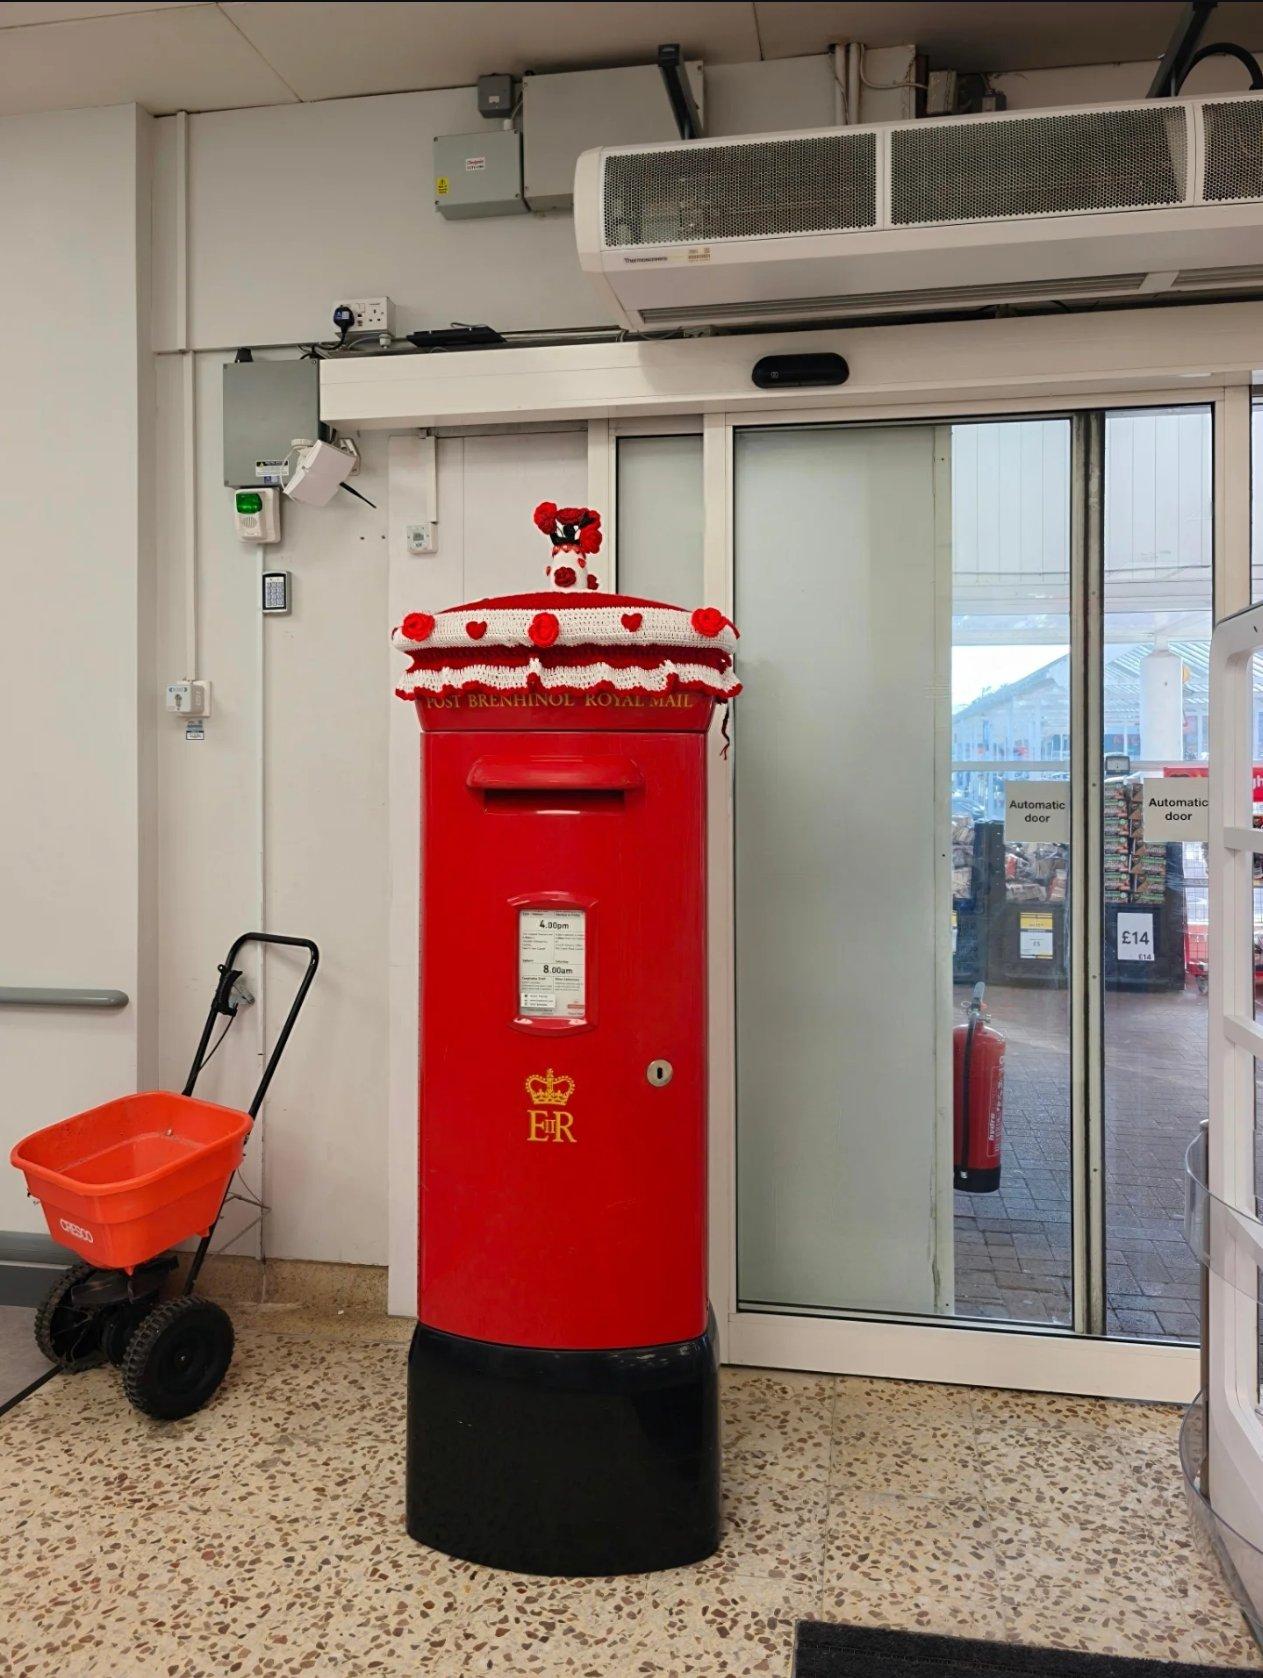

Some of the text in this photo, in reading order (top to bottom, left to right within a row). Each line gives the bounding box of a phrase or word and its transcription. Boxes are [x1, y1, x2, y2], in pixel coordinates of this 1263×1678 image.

[426, 693, 694, 708] POST BRENHINOL ROYAL MAIL
[1009, 800, 1066, 810] Automatic
[1148, 798, 1209, 808] Automatic
[1025, 813, 1051, 823] door
[1164, 811, 1193, 821] door
[539, 919, 569, 930] 4.00pm
[1121, 930, 1150, 946] £14
[60, 1218, 94, 1243] CRESCO
